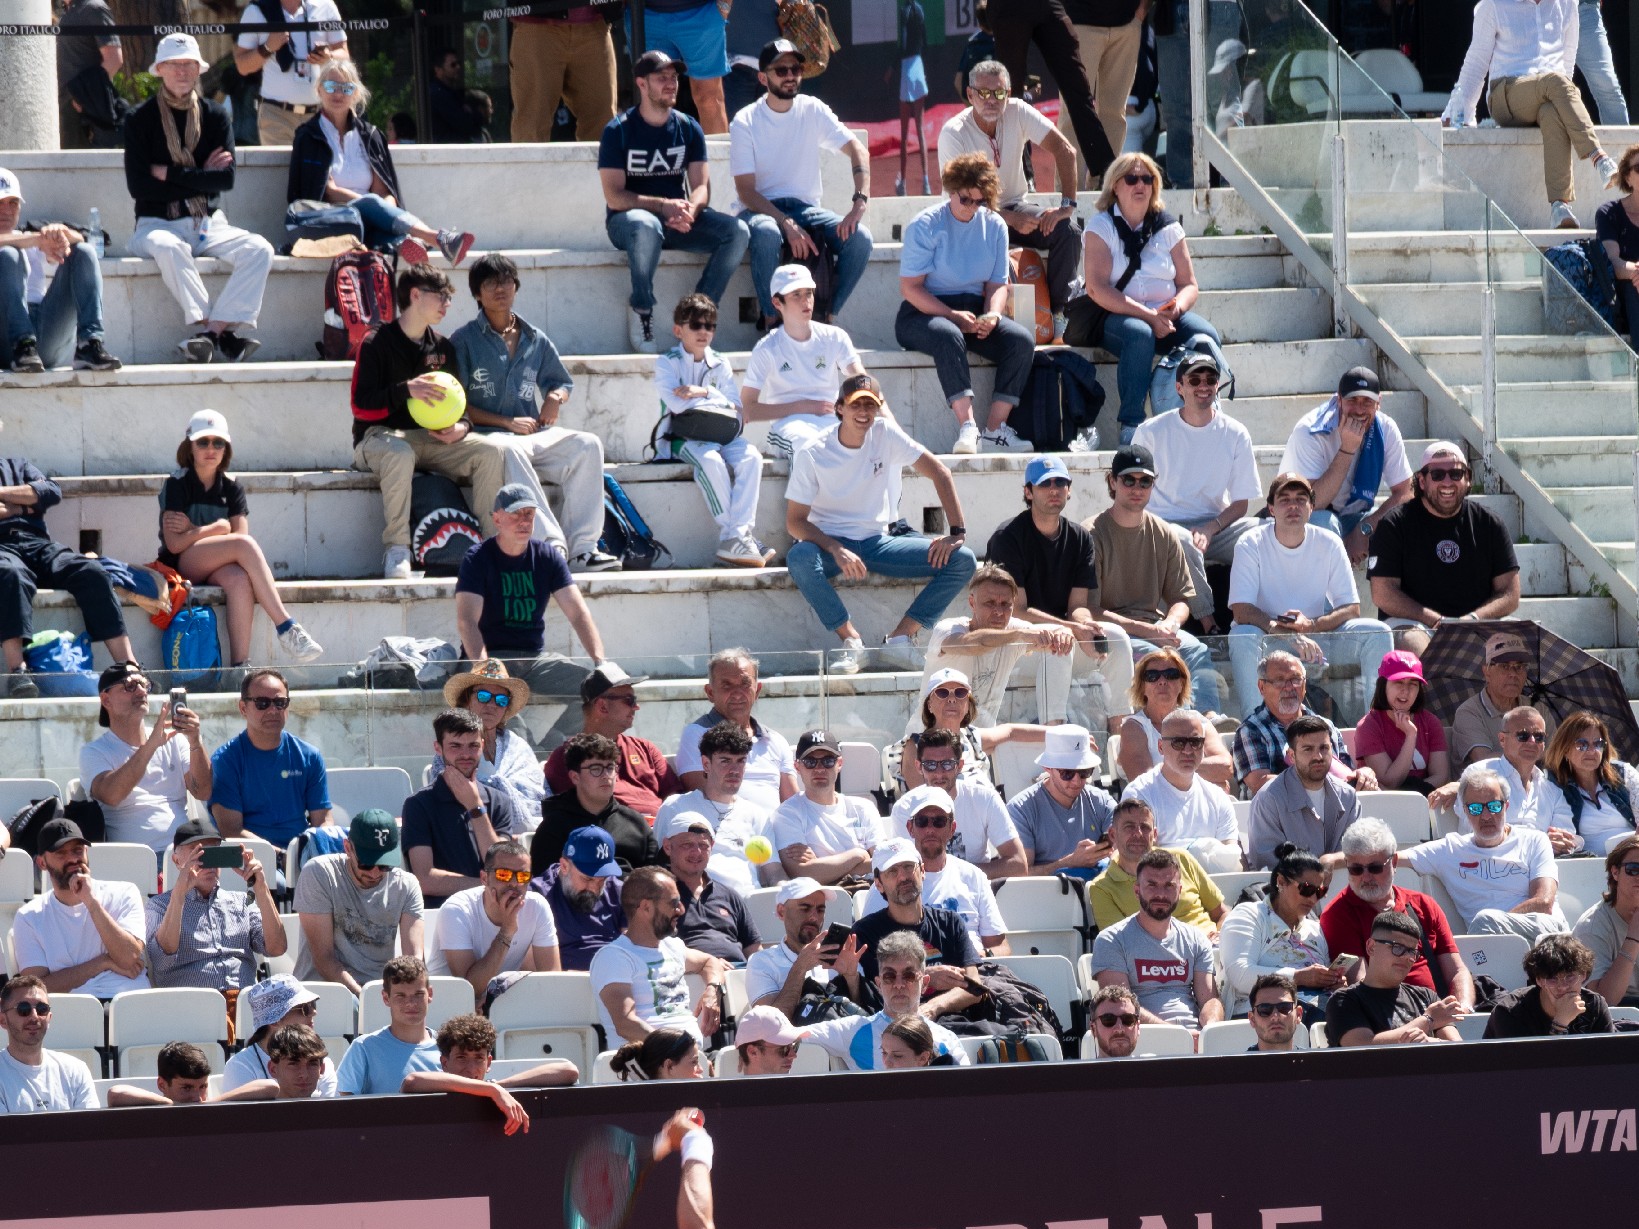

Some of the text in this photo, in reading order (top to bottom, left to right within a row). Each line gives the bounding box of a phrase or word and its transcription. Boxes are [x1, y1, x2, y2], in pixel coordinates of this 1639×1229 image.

[0, 25, 61, 35] RO ITALICO
[153, 24, 226, 35] FORO ITALICO
[318, 18, 389, 32] FORO ITALICO
[627, 145, 686, 172] EA7
[501, 570, 536, 597] DUN
[1458, 859, 1528, 880] FILA
[1540, 1108, 1637, 1155] WTA
